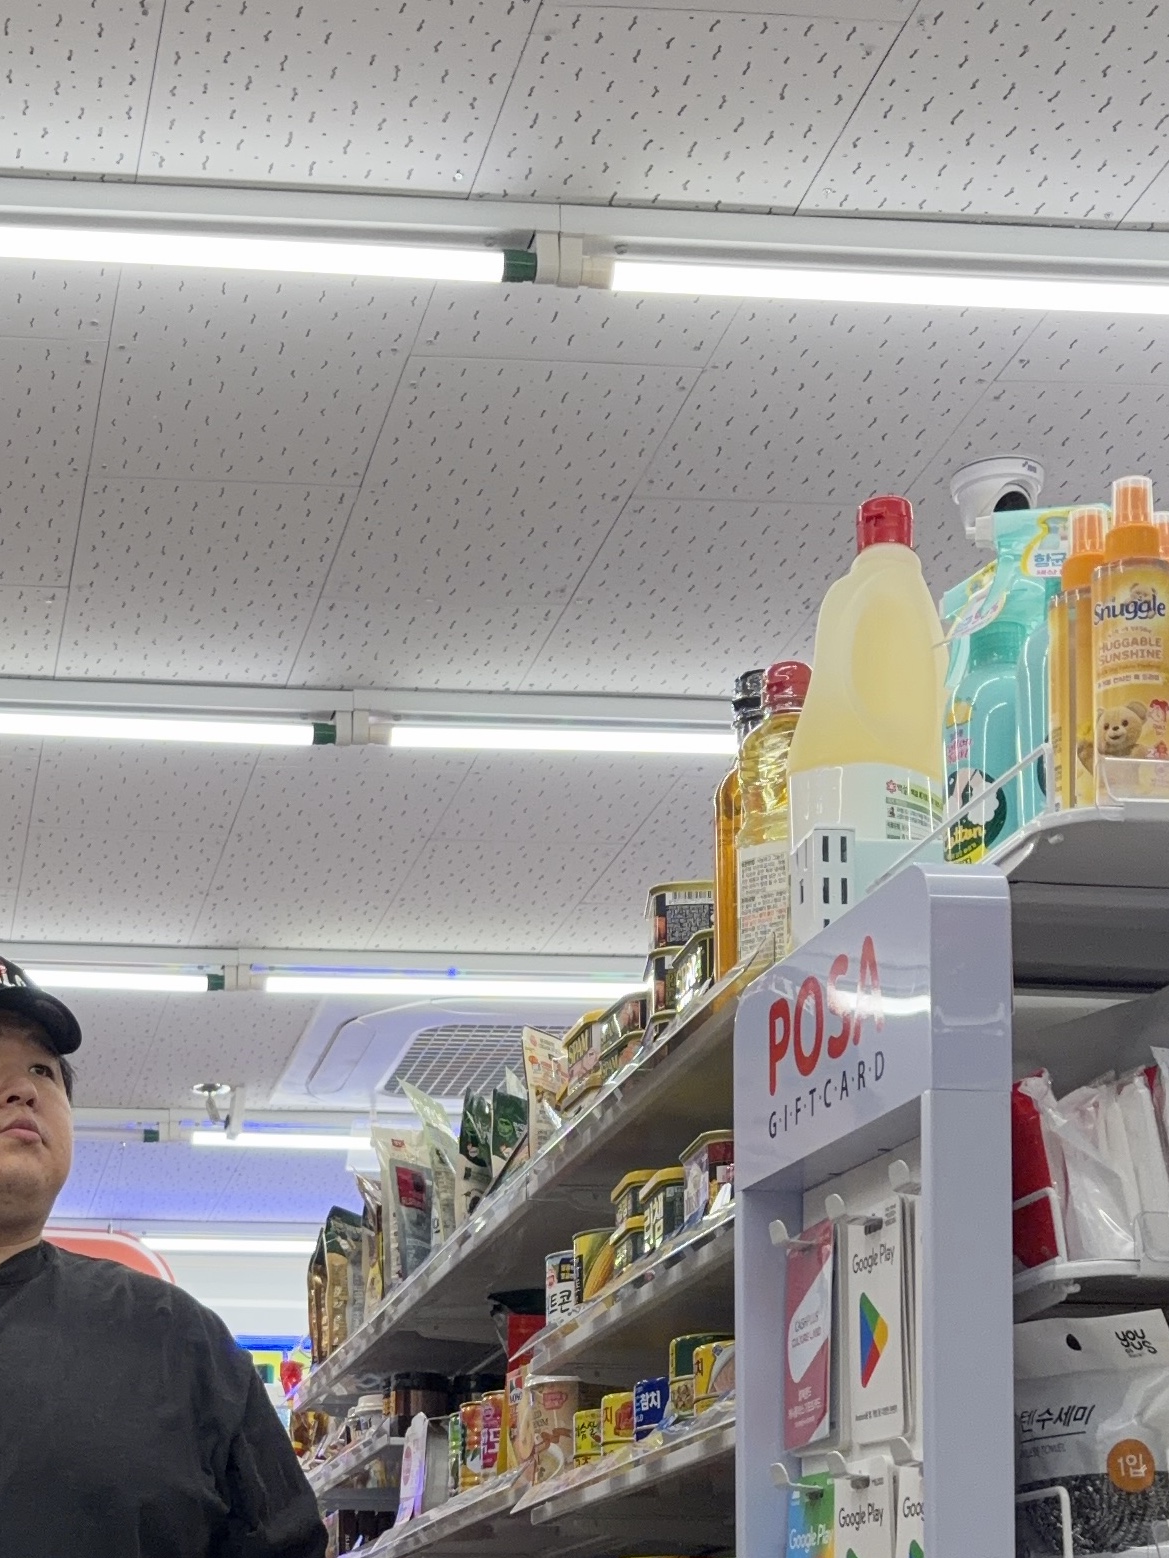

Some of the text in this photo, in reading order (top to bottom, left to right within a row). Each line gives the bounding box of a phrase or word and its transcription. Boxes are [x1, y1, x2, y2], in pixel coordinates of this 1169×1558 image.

[1093, 593, 1167, 626] Snuggle
[1099, 648, 1162, 666] SUNSHINE
[1100, 635, 1163, 655] HUGGABLE
[768, 934, 886, 1097] POSA
[852, 1242, 896, 1274] Google Play
[838, 1502, 885, 1531] Google Play
[789, 1527, 817, 1554] Google
